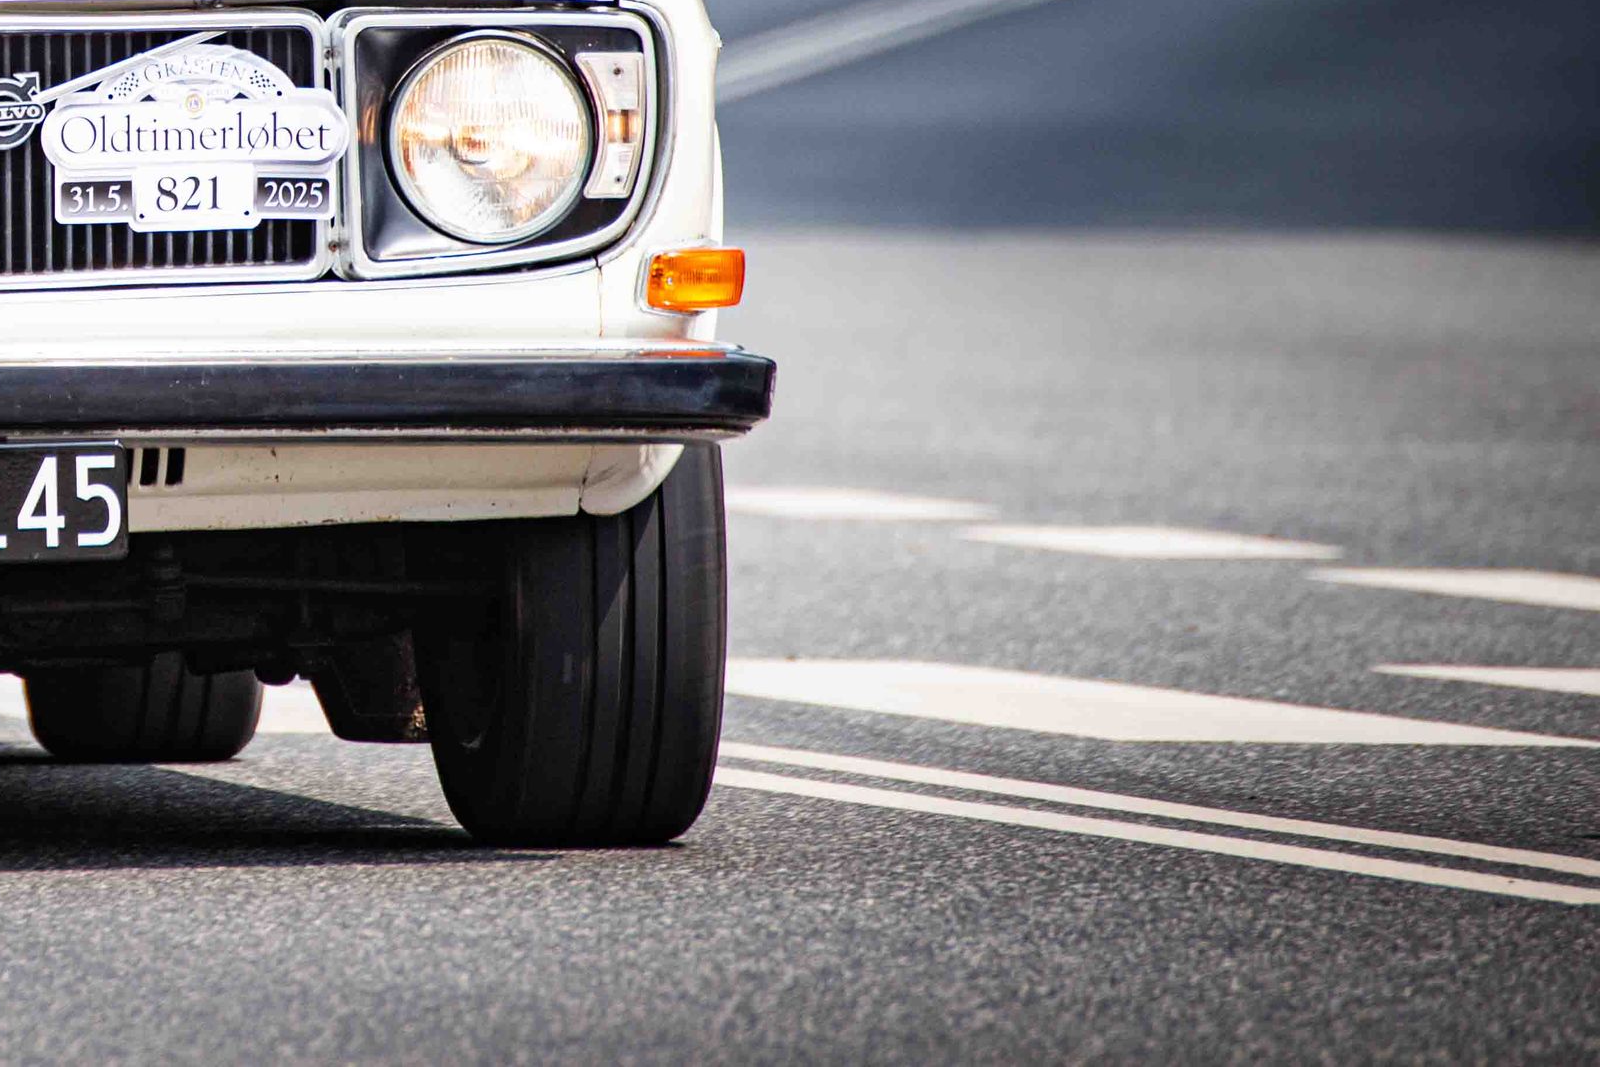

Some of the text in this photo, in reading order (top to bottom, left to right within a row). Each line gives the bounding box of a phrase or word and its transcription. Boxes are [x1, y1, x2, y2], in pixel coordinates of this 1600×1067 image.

[61, 111, 331, 155] Oldtimerløbet
[69, 176, 323, 213] 31.5. 821 2025
